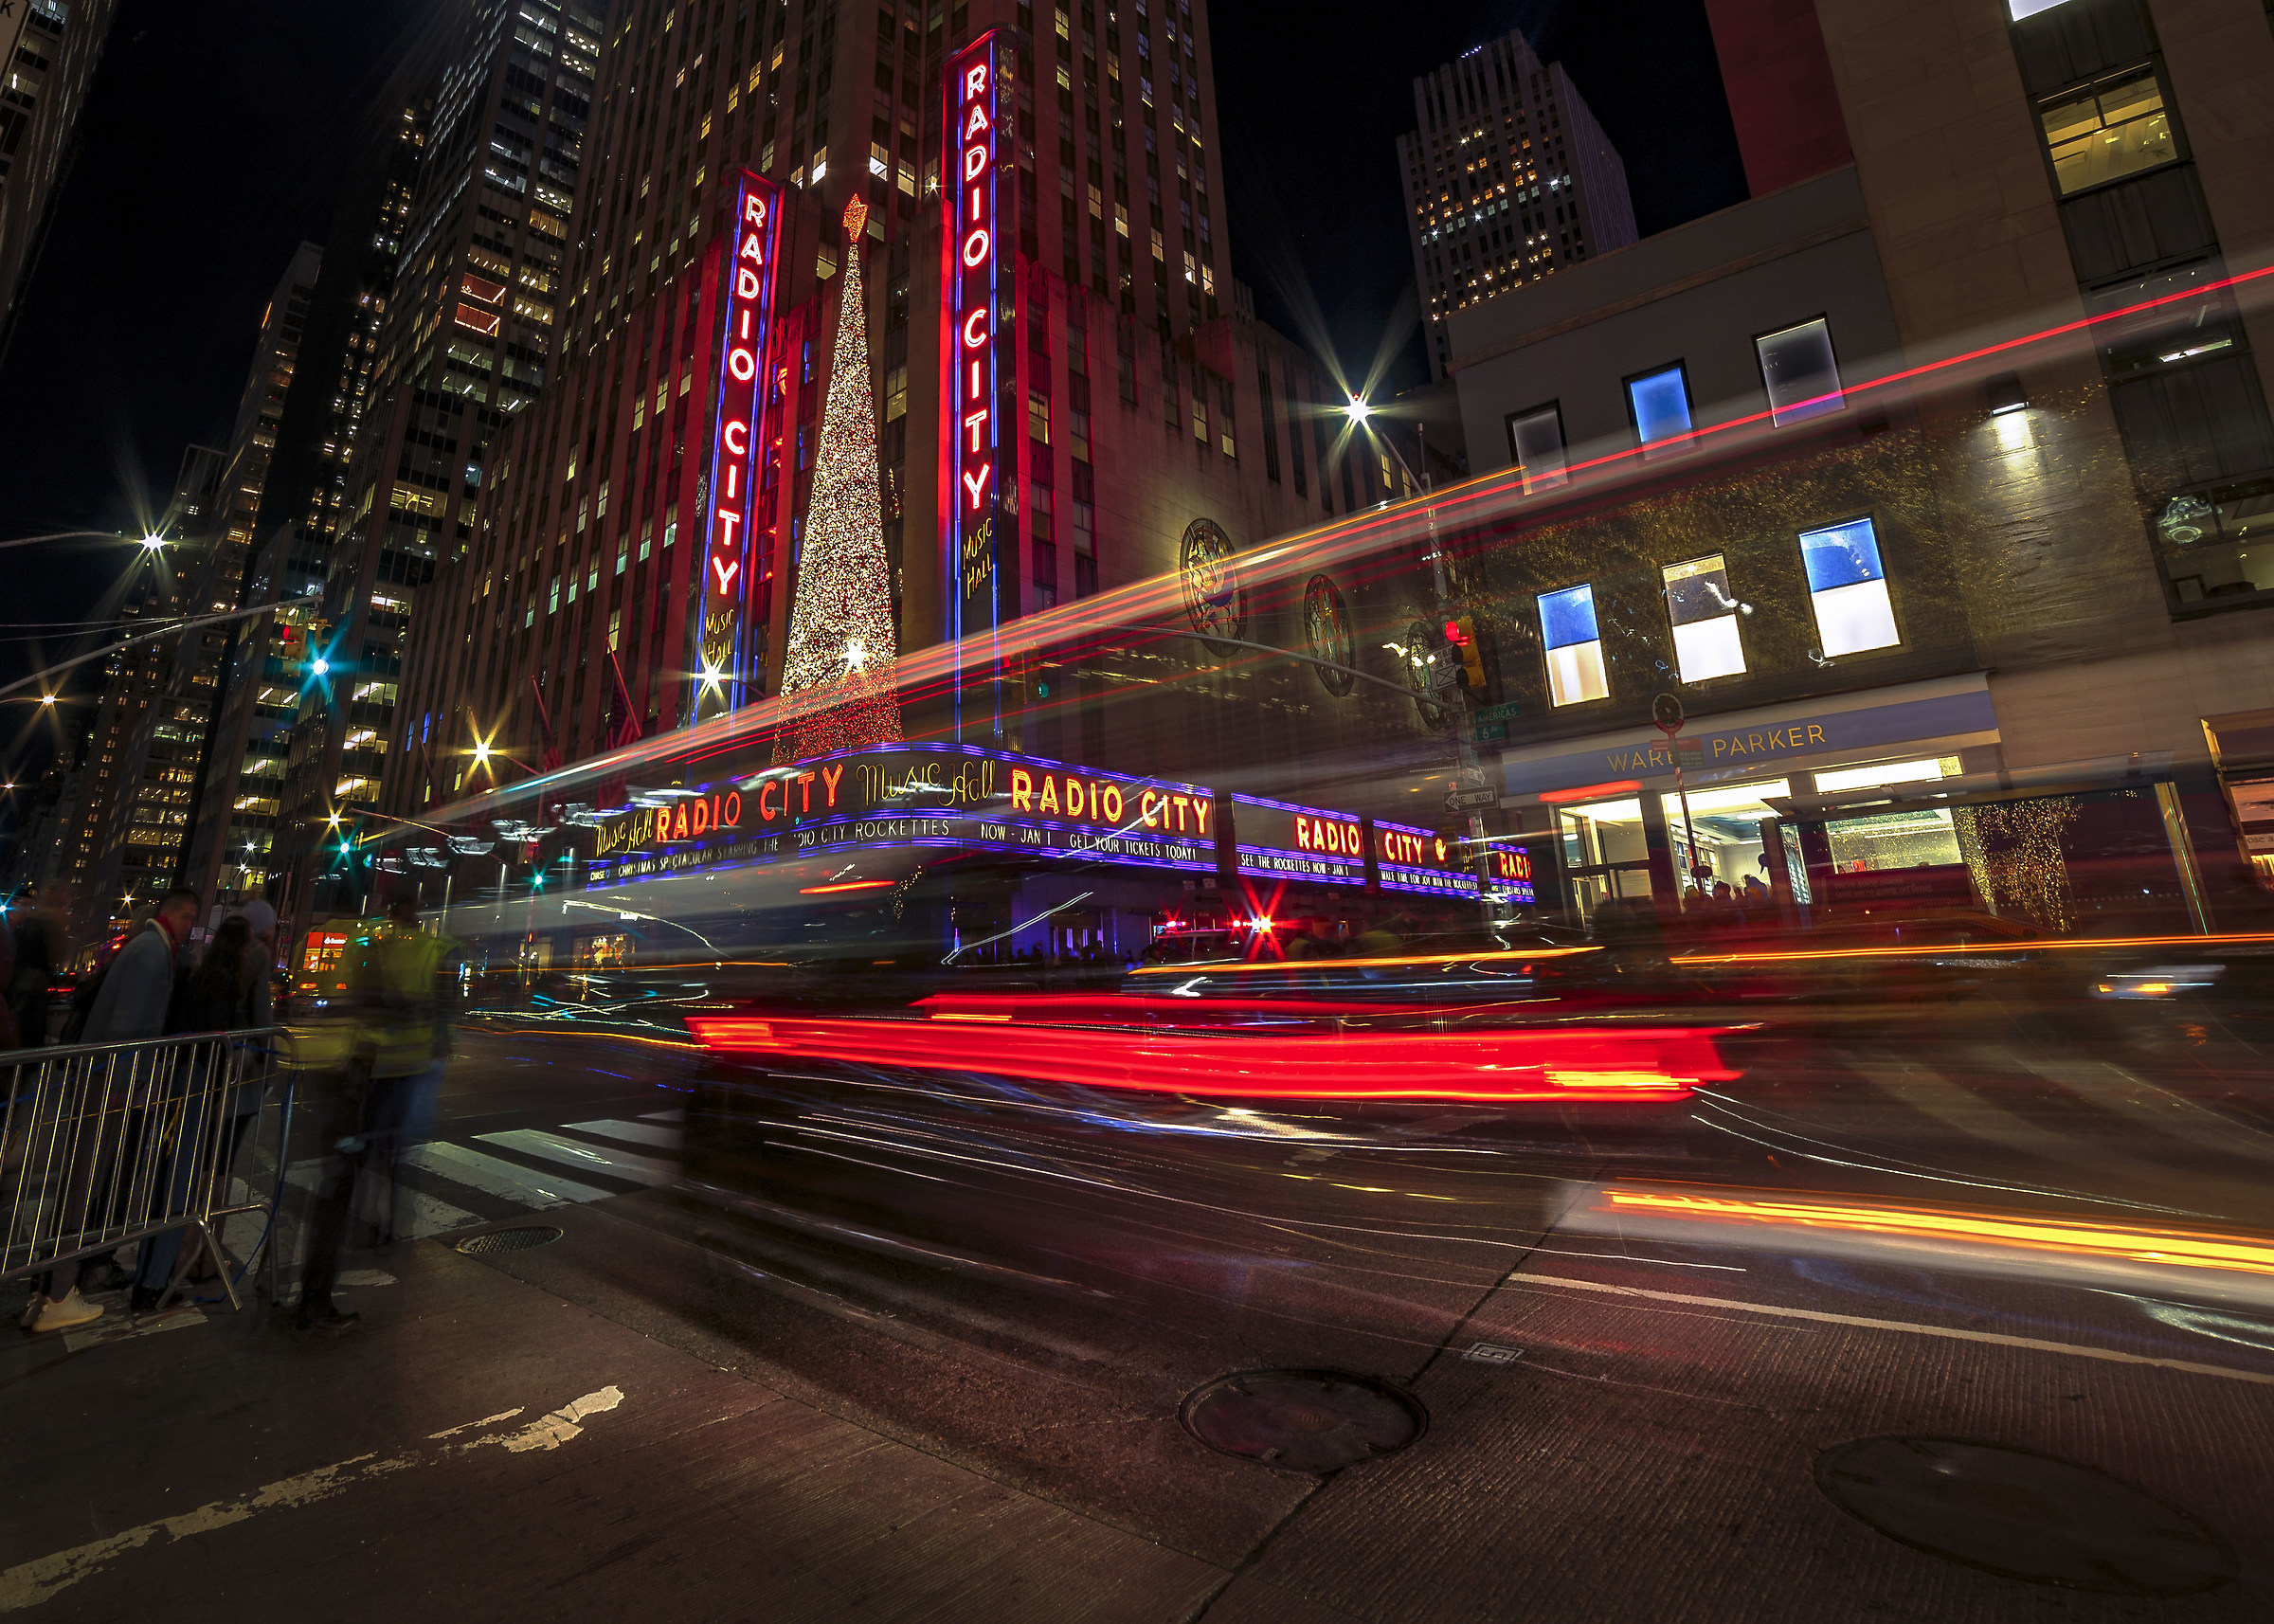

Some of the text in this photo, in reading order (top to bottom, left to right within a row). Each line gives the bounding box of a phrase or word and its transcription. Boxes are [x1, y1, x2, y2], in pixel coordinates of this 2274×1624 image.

[963, 63, 990, 510] RADIO CITY
[712, 193, 766, 595] RADIO CITY
[963, 517, 993, 568] MUSIC
[966, 552, 993, 599] HALL
[704, 608, 734, 640] MUSIC
[1477, 707, 1517, 724] AMERICAS
[1482, 728, 1489, 739] 6
[1711, 724, 1827, 758] PARKER
[656, 791, 741, 842] RADIO
[759, 763, 843, 821] CITY
[1011, 767, 1124, 823] RADIO
[1141, 790, 1208, 835] CITY
[1449, 792, 1491, 806] ONE WAY
[589, 870, 605, 881] CHASE
[618, 858, 656, 877] CHRISTMAS
[764, 837, 779, 853] THE
[821, 824, 846, 844] CITY
[855, 820, 949, 841] ROCKETTES
[981, 823, 1006, 840] NOW
[1020, 828, 1041, 844] JAN
[1070, 833, 1197, 861] GET YOUR TICKETS TODAY!
[1295, 816, 1361, 856] RADIO
[1384, 831, 1423, 864] CITY
[1241, 854, 1254, 867] SEE
[1257, 856, 1271, 869] THE
[1273, 857, 1310, 874] ROCKETTES
[1312, 862, 1326, 875] NOW
[1332, 863, 1345, 875] JAN
